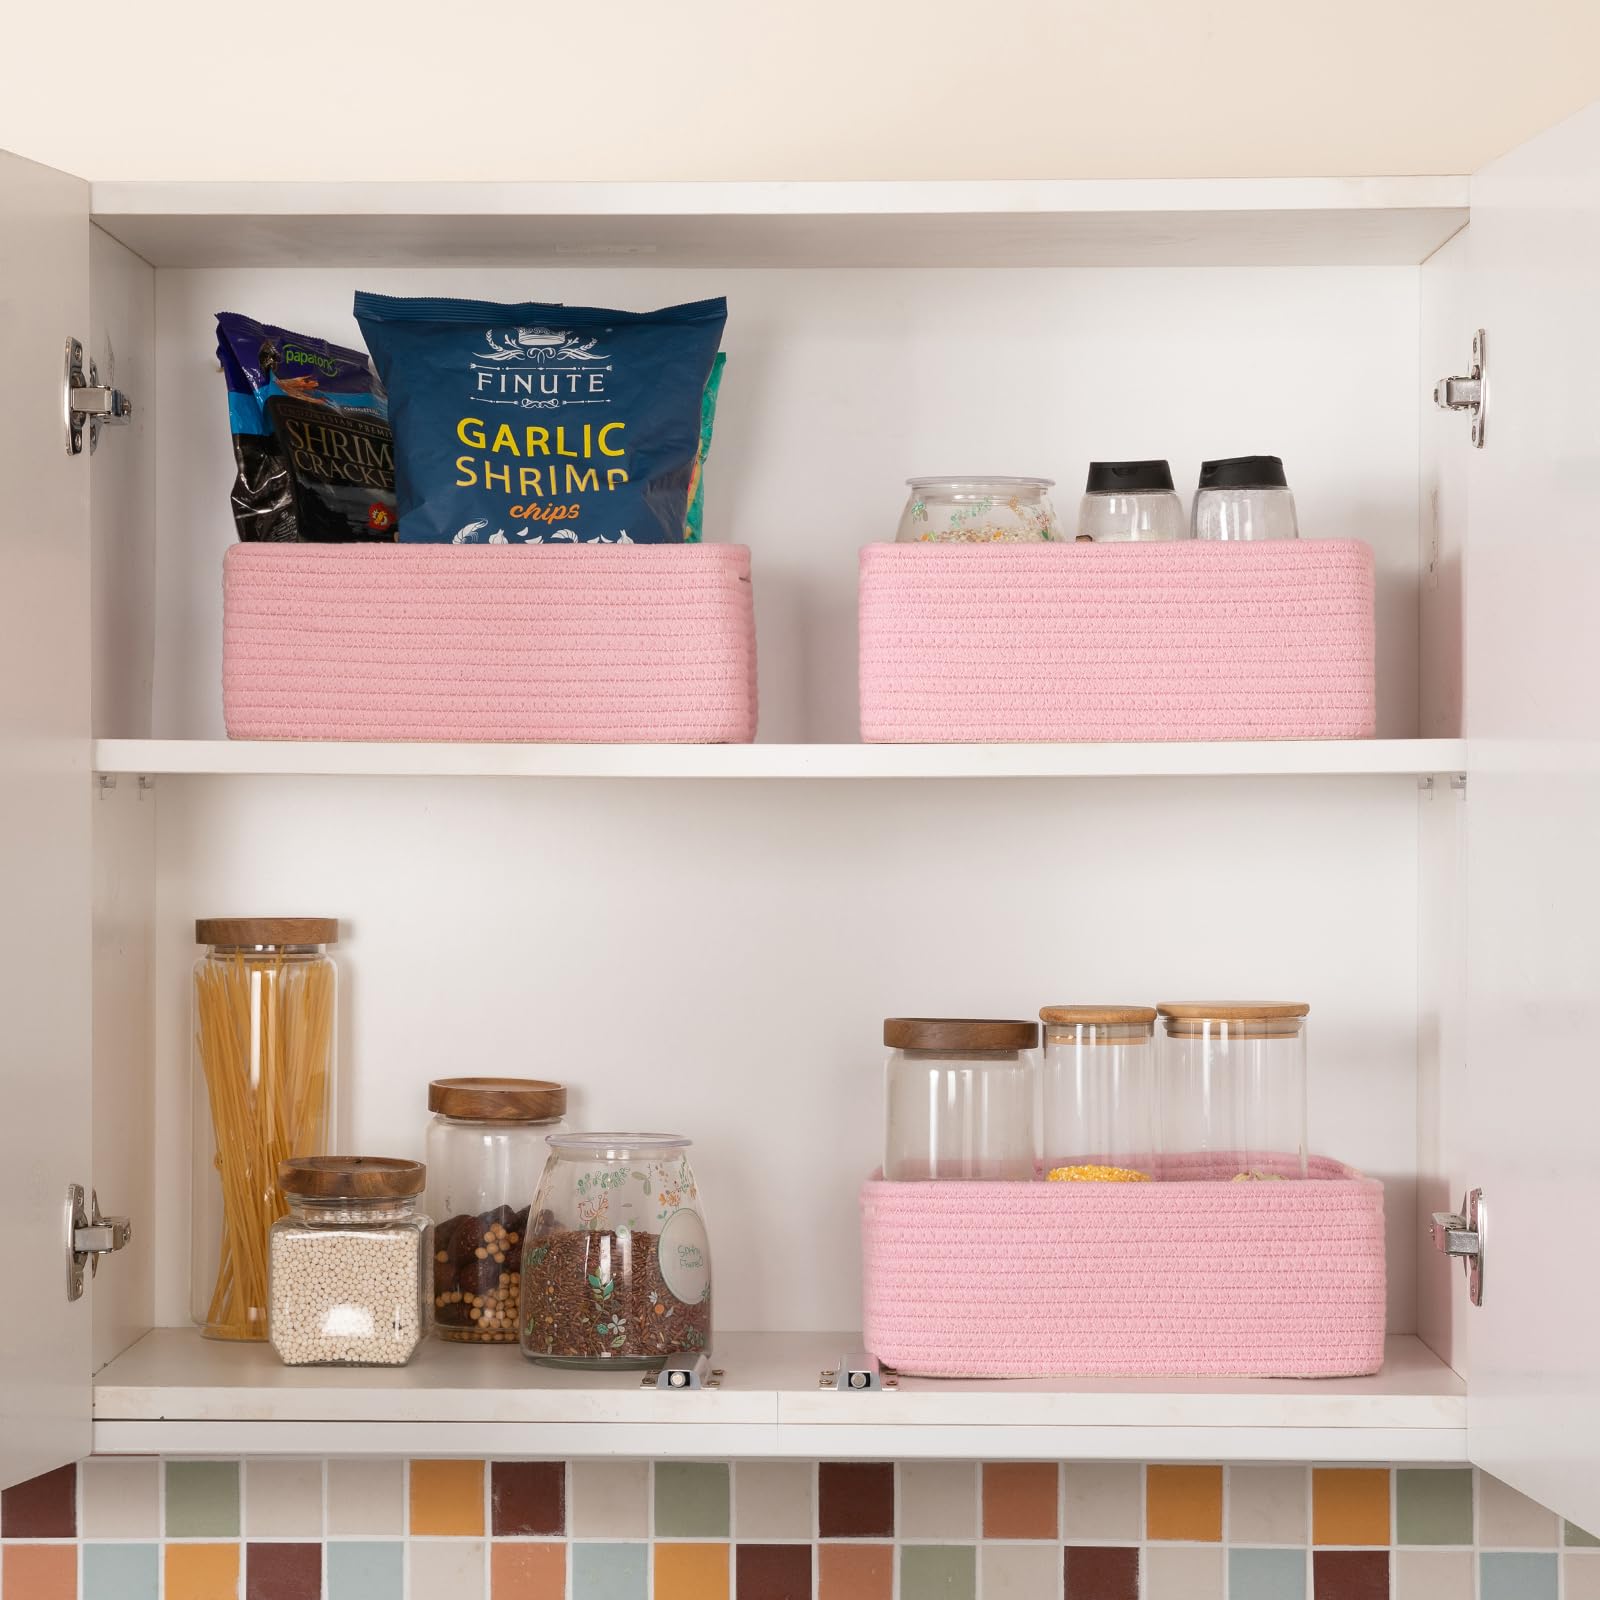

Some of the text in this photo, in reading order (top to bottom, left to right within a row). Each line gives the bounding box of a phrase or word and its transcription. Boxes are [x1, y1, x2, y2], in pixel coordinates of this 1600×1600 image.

[477, 372, 605, 395] FINUTE
[286, 419, 395, 471] SHRIM
[358, 422, 392, 439] PREMI
[456, 416, 626, 459] GARLIC
[294, 449, 394, 488] CRACKE
[455, 455, 630, 498] SHRIMP
[509, 502, 581, 525] chips
